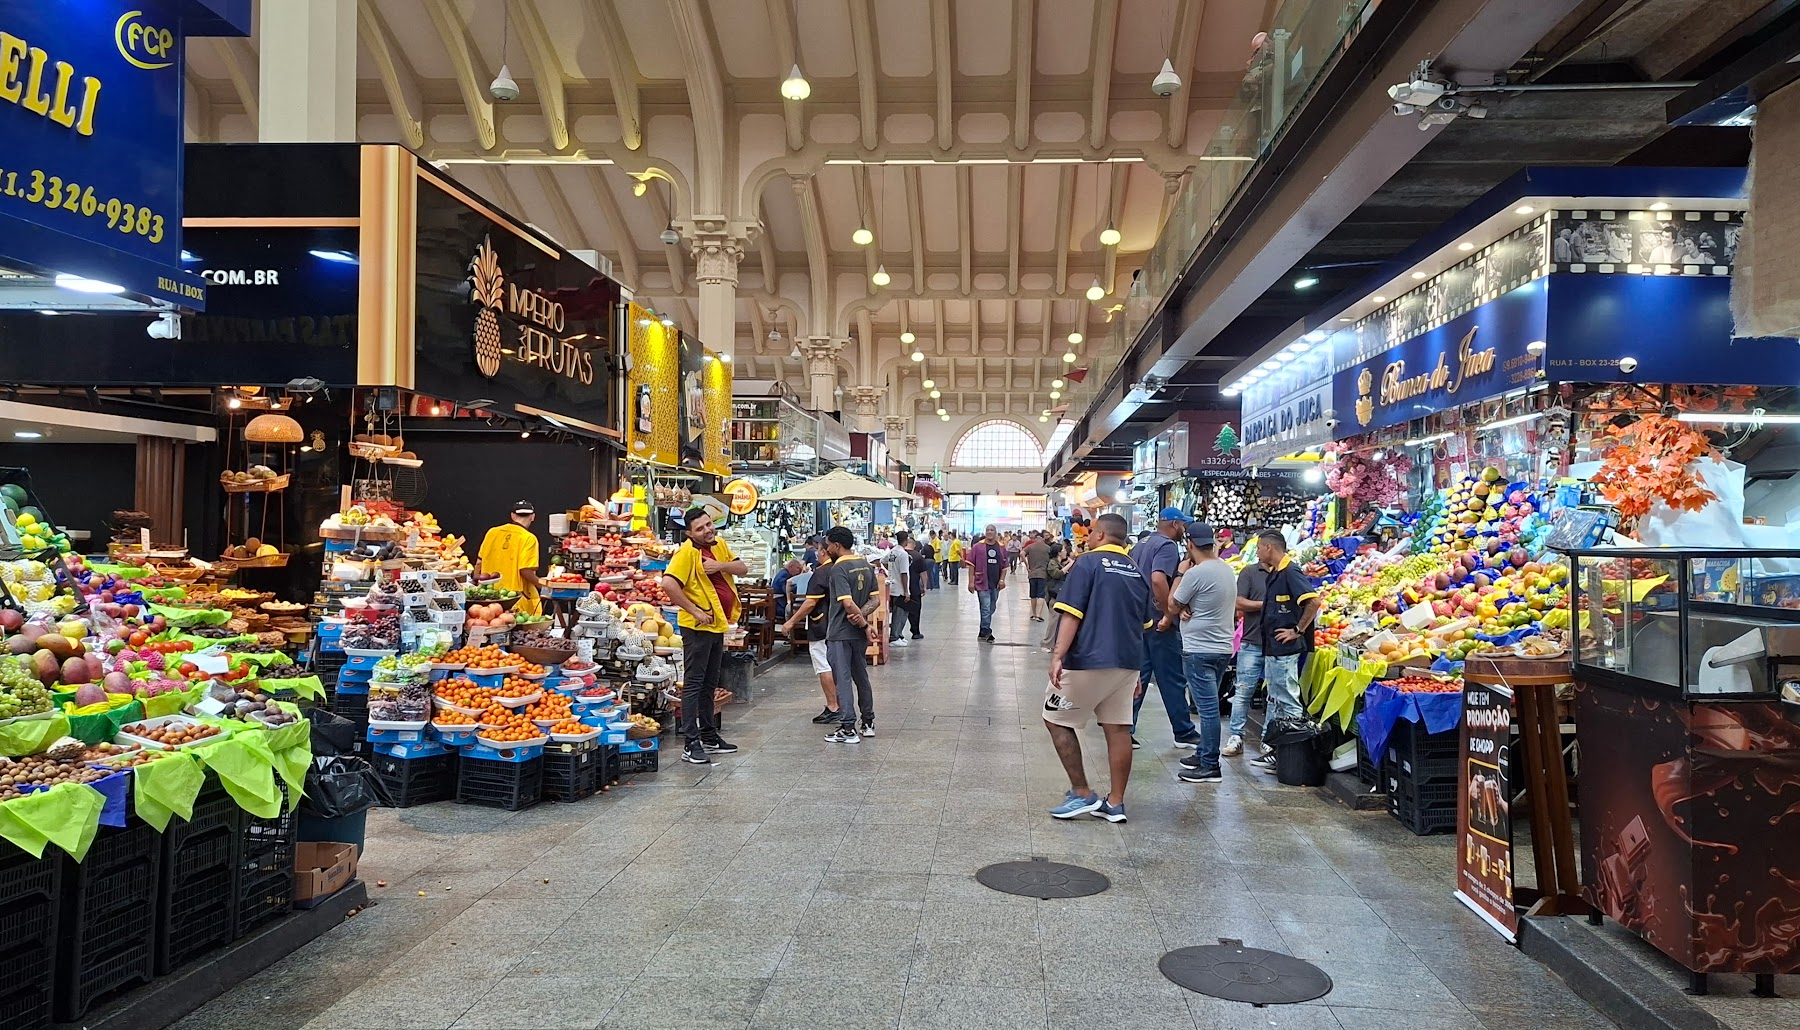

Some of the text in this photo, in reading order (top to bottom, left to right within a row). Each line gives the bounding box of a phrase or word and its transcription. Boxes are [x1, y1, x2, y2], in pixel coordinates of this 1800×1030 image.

[128, 23, 174, 58] FCP
[0, 31, 102, 136] ELLI
[0, 169, 164, 243] 1.3326-9383
[158, 276, 204, 300] RUA I BOX
[527, 327, 593, 385] FRUTAS
[1280, 406, 1293, 432] DO
[1295, 393, 1323, 427] JUCA
[1479, 691, 1490, 706] TEM
[1466, 704, 1510, 732] PROMOÇÃO
[1469, 737, 1494, 754] DE CHOPP
